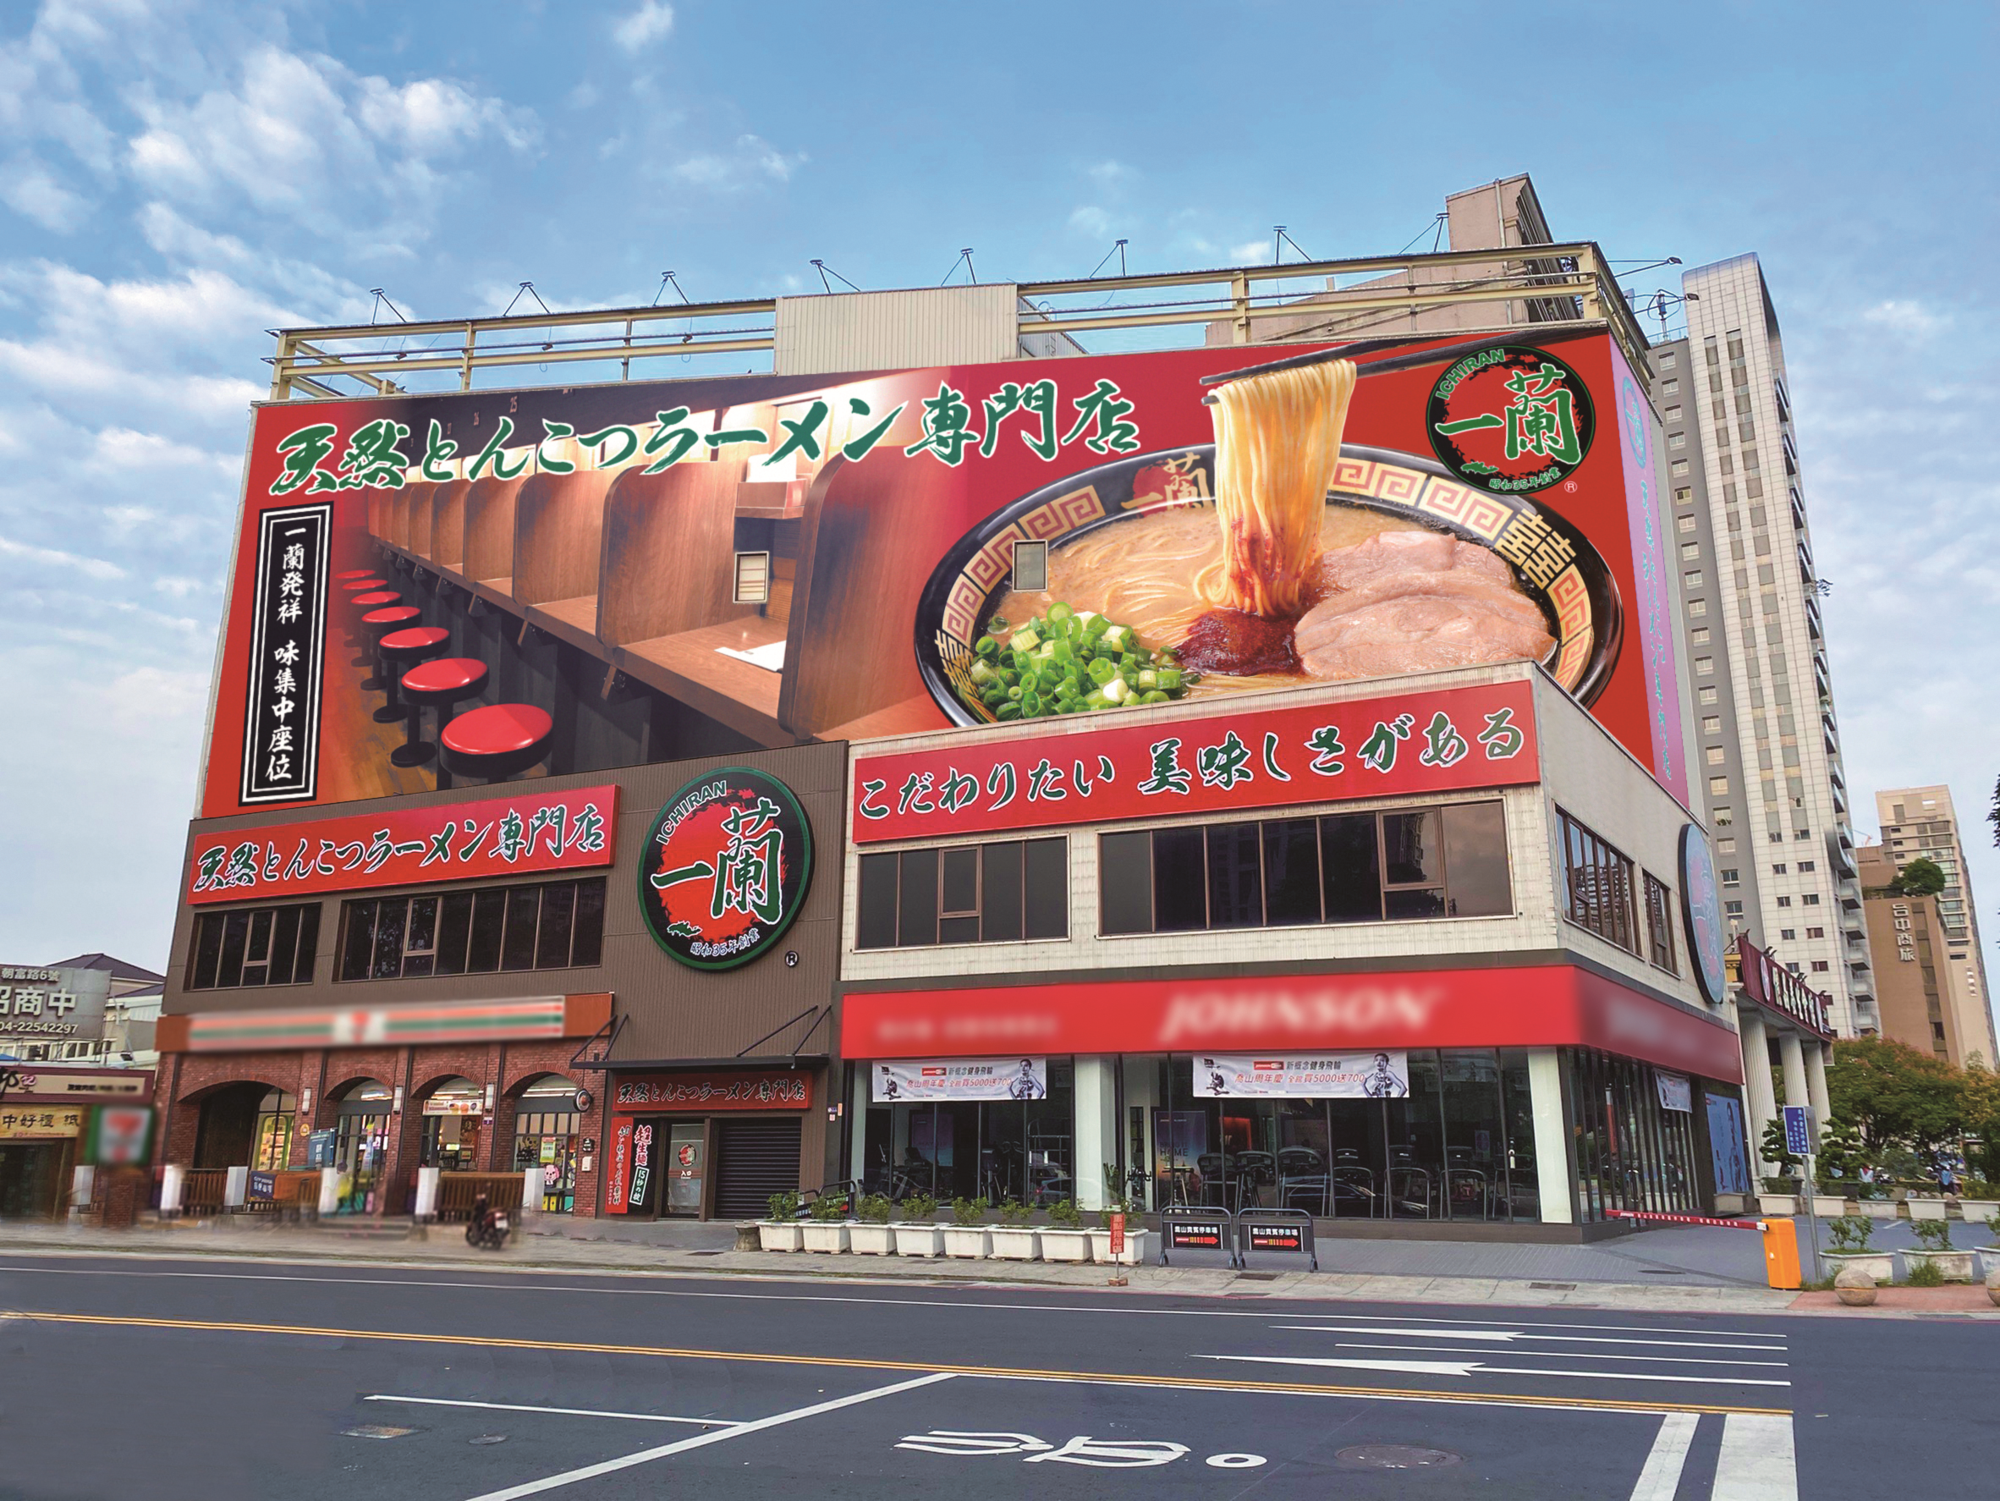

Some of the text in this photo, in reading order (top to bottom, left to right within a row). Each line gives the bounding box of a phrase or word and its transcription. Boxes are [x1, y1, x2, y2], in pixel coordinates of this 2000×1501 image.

[1435, 363, 1582, 465] 一蘭
[1436, 349, 1505, 400] ICHIRAN
[270, 379, 1141, 496] 天然とんこつラーメン専門店
[265, 526, 307, 782] 一蘭発祥 味集中座位
[858, 707, 1524, 819] こだわりたい 美味しさがある
[192, 803, 606, 892] 天然とんこつラーメン専門店
[656, 780, 727, 845] ICHIRAN
[650, 797, 783, 925] 一蘭
[2, 968, 60, 982] 朝富路6號
[617, 1079, 805, 1104] 天然とんこつラーメン専門店
